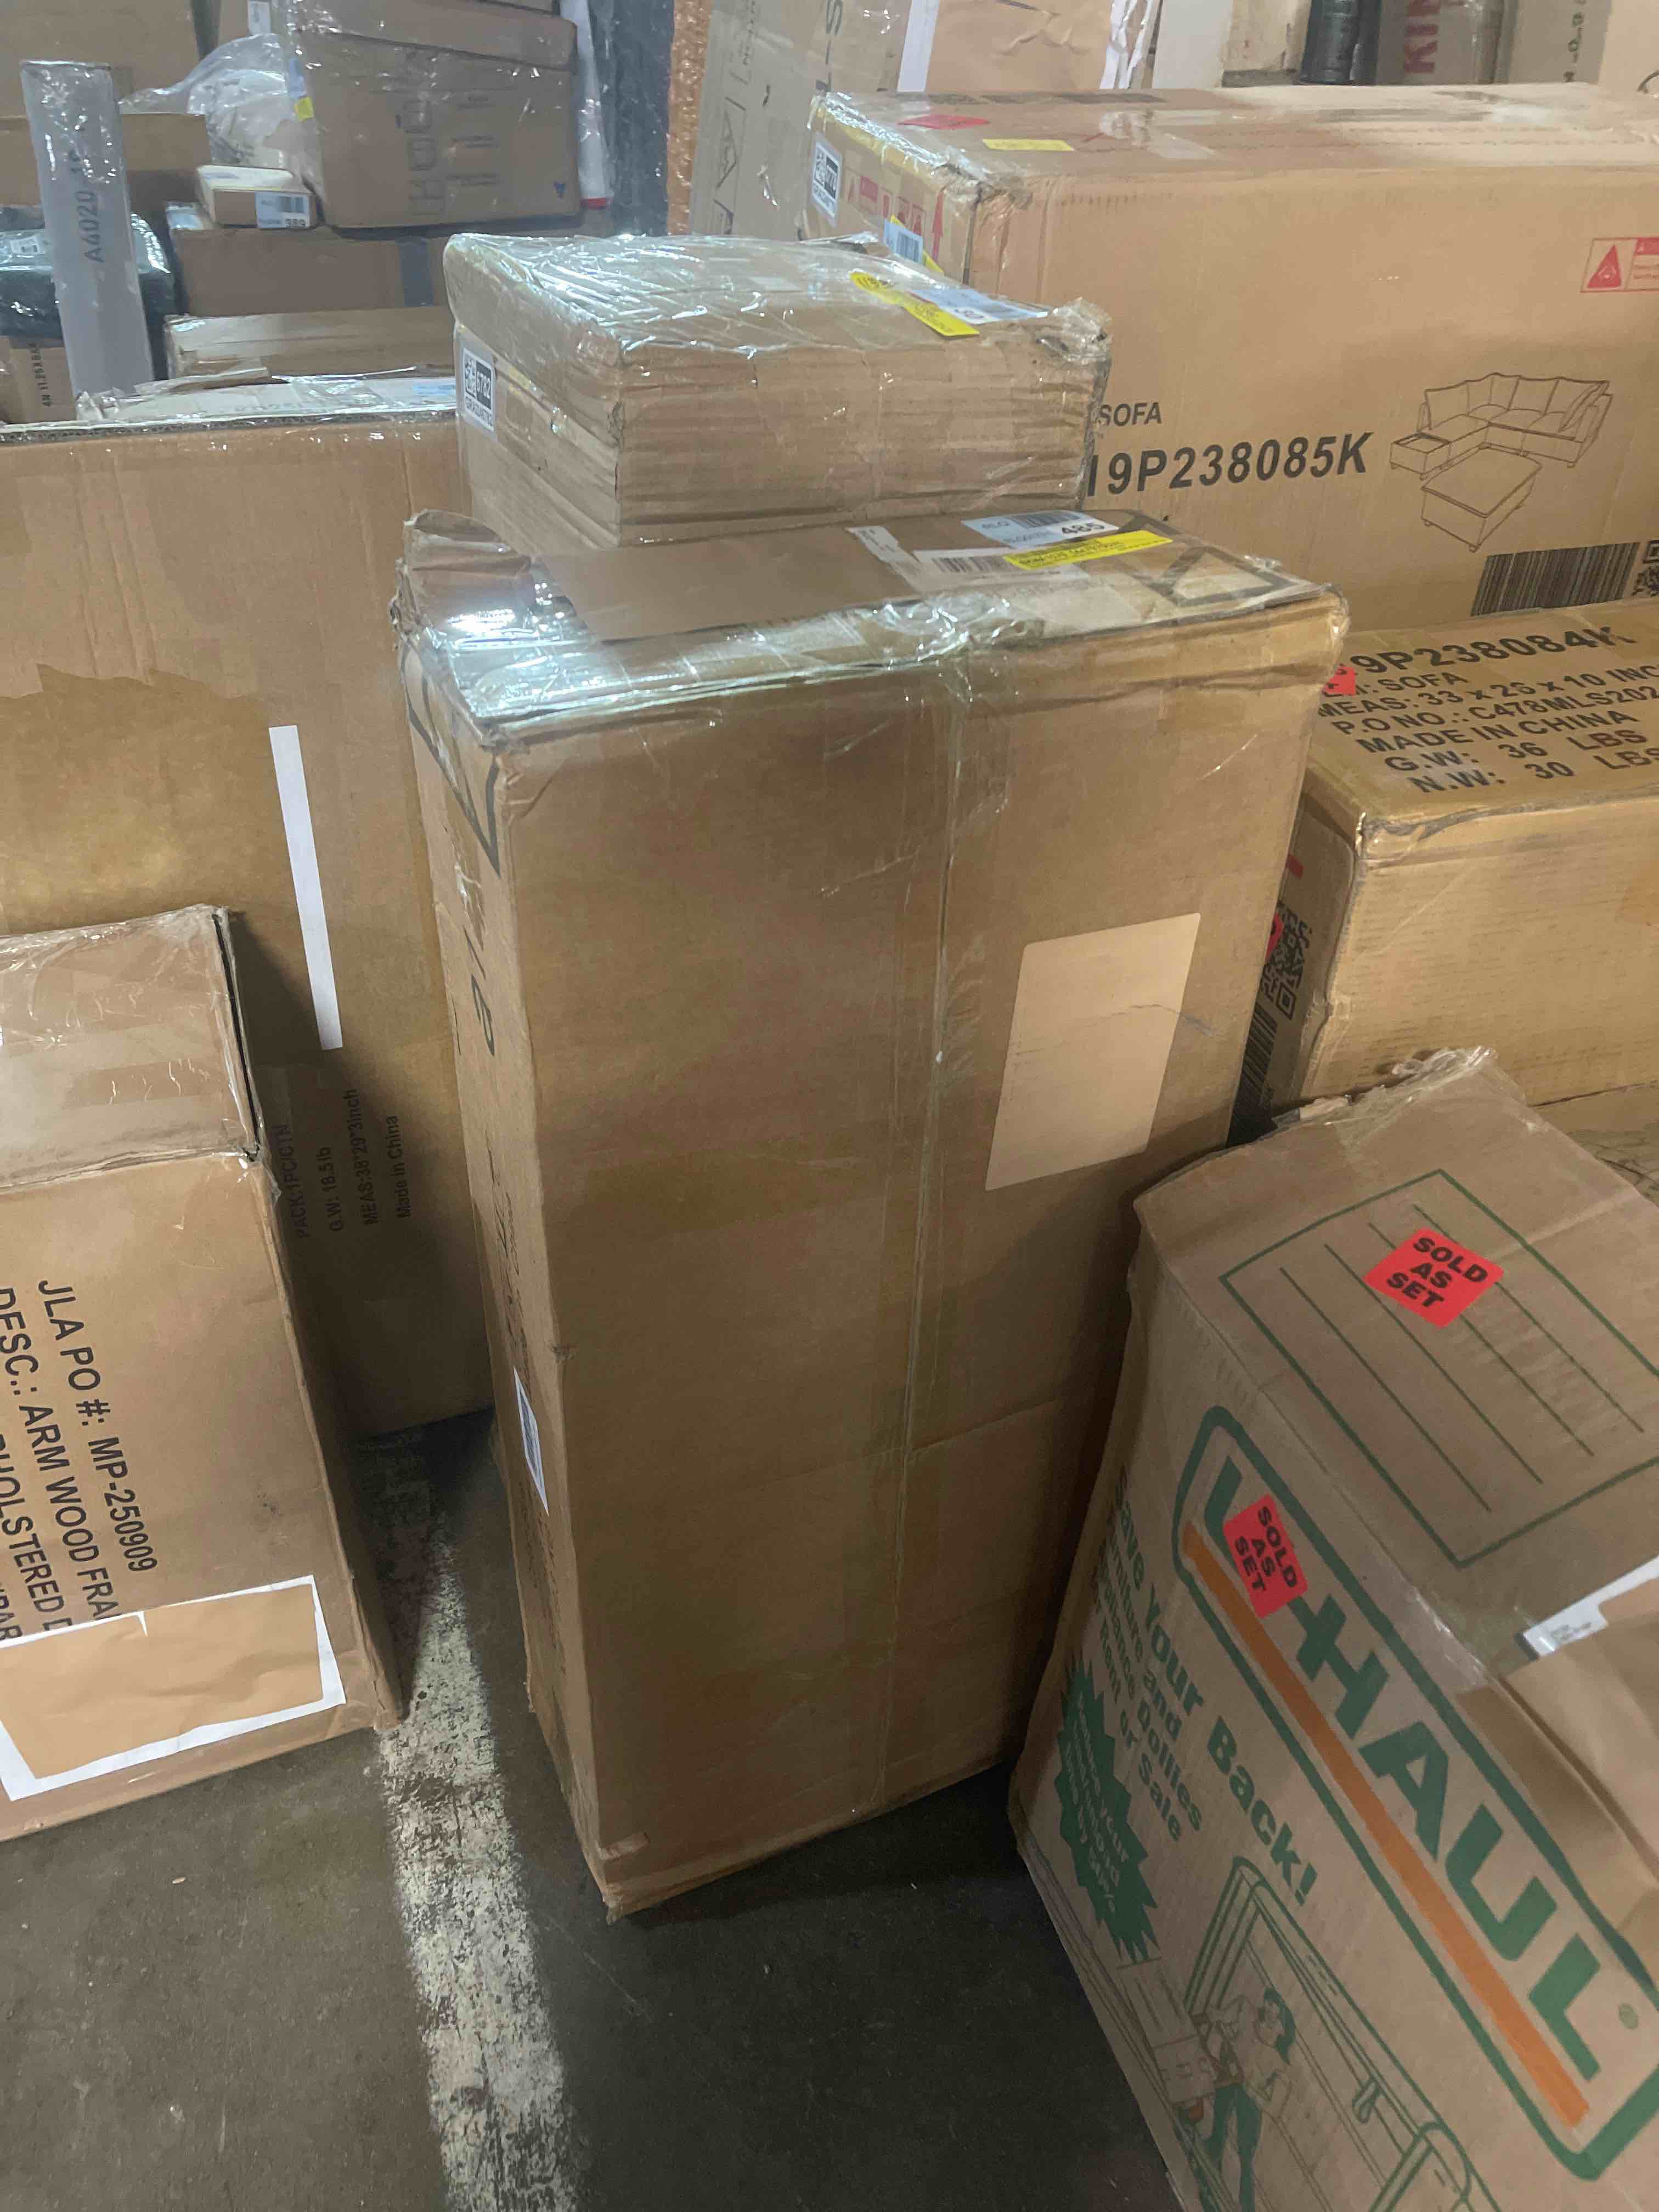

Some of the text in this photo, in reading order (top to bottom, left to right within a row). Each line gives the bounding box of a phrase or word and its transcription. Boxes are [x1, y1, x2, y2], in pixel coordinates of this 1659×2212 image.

[1099, 402, 1163, 427] SOFA
[1087, 431, 1374, 496] 19P238085K
[1062, 522, 1105, 534] 485
[1350, 626, 1637, 674] 9P238084K
[1318, 697, 1420, 717] MEAS:
[1418, 690, 1463, 706] 33
[1465, 689, 1493, 700] x
[1536, 681, 1565, 692] x
[1564, 673, 1606, 688] 10
[1377, 672, 1470, 691] SOFA
[1356, 710, 1640, 753] MADE IN CHINA
[1384, 729, 1649, 771] G.W: 36 LBS
[1407, 769, 1505, 793] N.W:
[1525, 761, 1575, 780] 30
[385, 1115, 412, 1218] Made in China
[1410, 1262, 1453, 1289] AS
[1413, 1237, 1488, 1283] SOLD
[38, 1280, 84, 1341] JLA
[1386, 1272, 1444, 1308] SET
[60, 1346, 101, 1391] PO
[0, 1434, 65, 1613] OLSTERED
[19, 1406, 70, 1471] ARM
[45, 1476, 100, 1562] WOOD
[77, 1567, 123, 1621] FRA
[87, 1436, 158, 1572] MP-250909
[1234, 1536, 1267, 1591] SET
[1250, 1538, 1276, 1577] AS
[1257, 1506, 1298, 1588] SOLD
[1142, 1668, 1182, 1743] and
[1137, 1699, 1202, 1832] Dollies
[1143, 1582, 1204, 1717] Your
[1206, 1715, 1318, 1906] Back!
[1120, 1708, 1138, 1750] or
[1138, 1752, 1181, 1842] Sale
